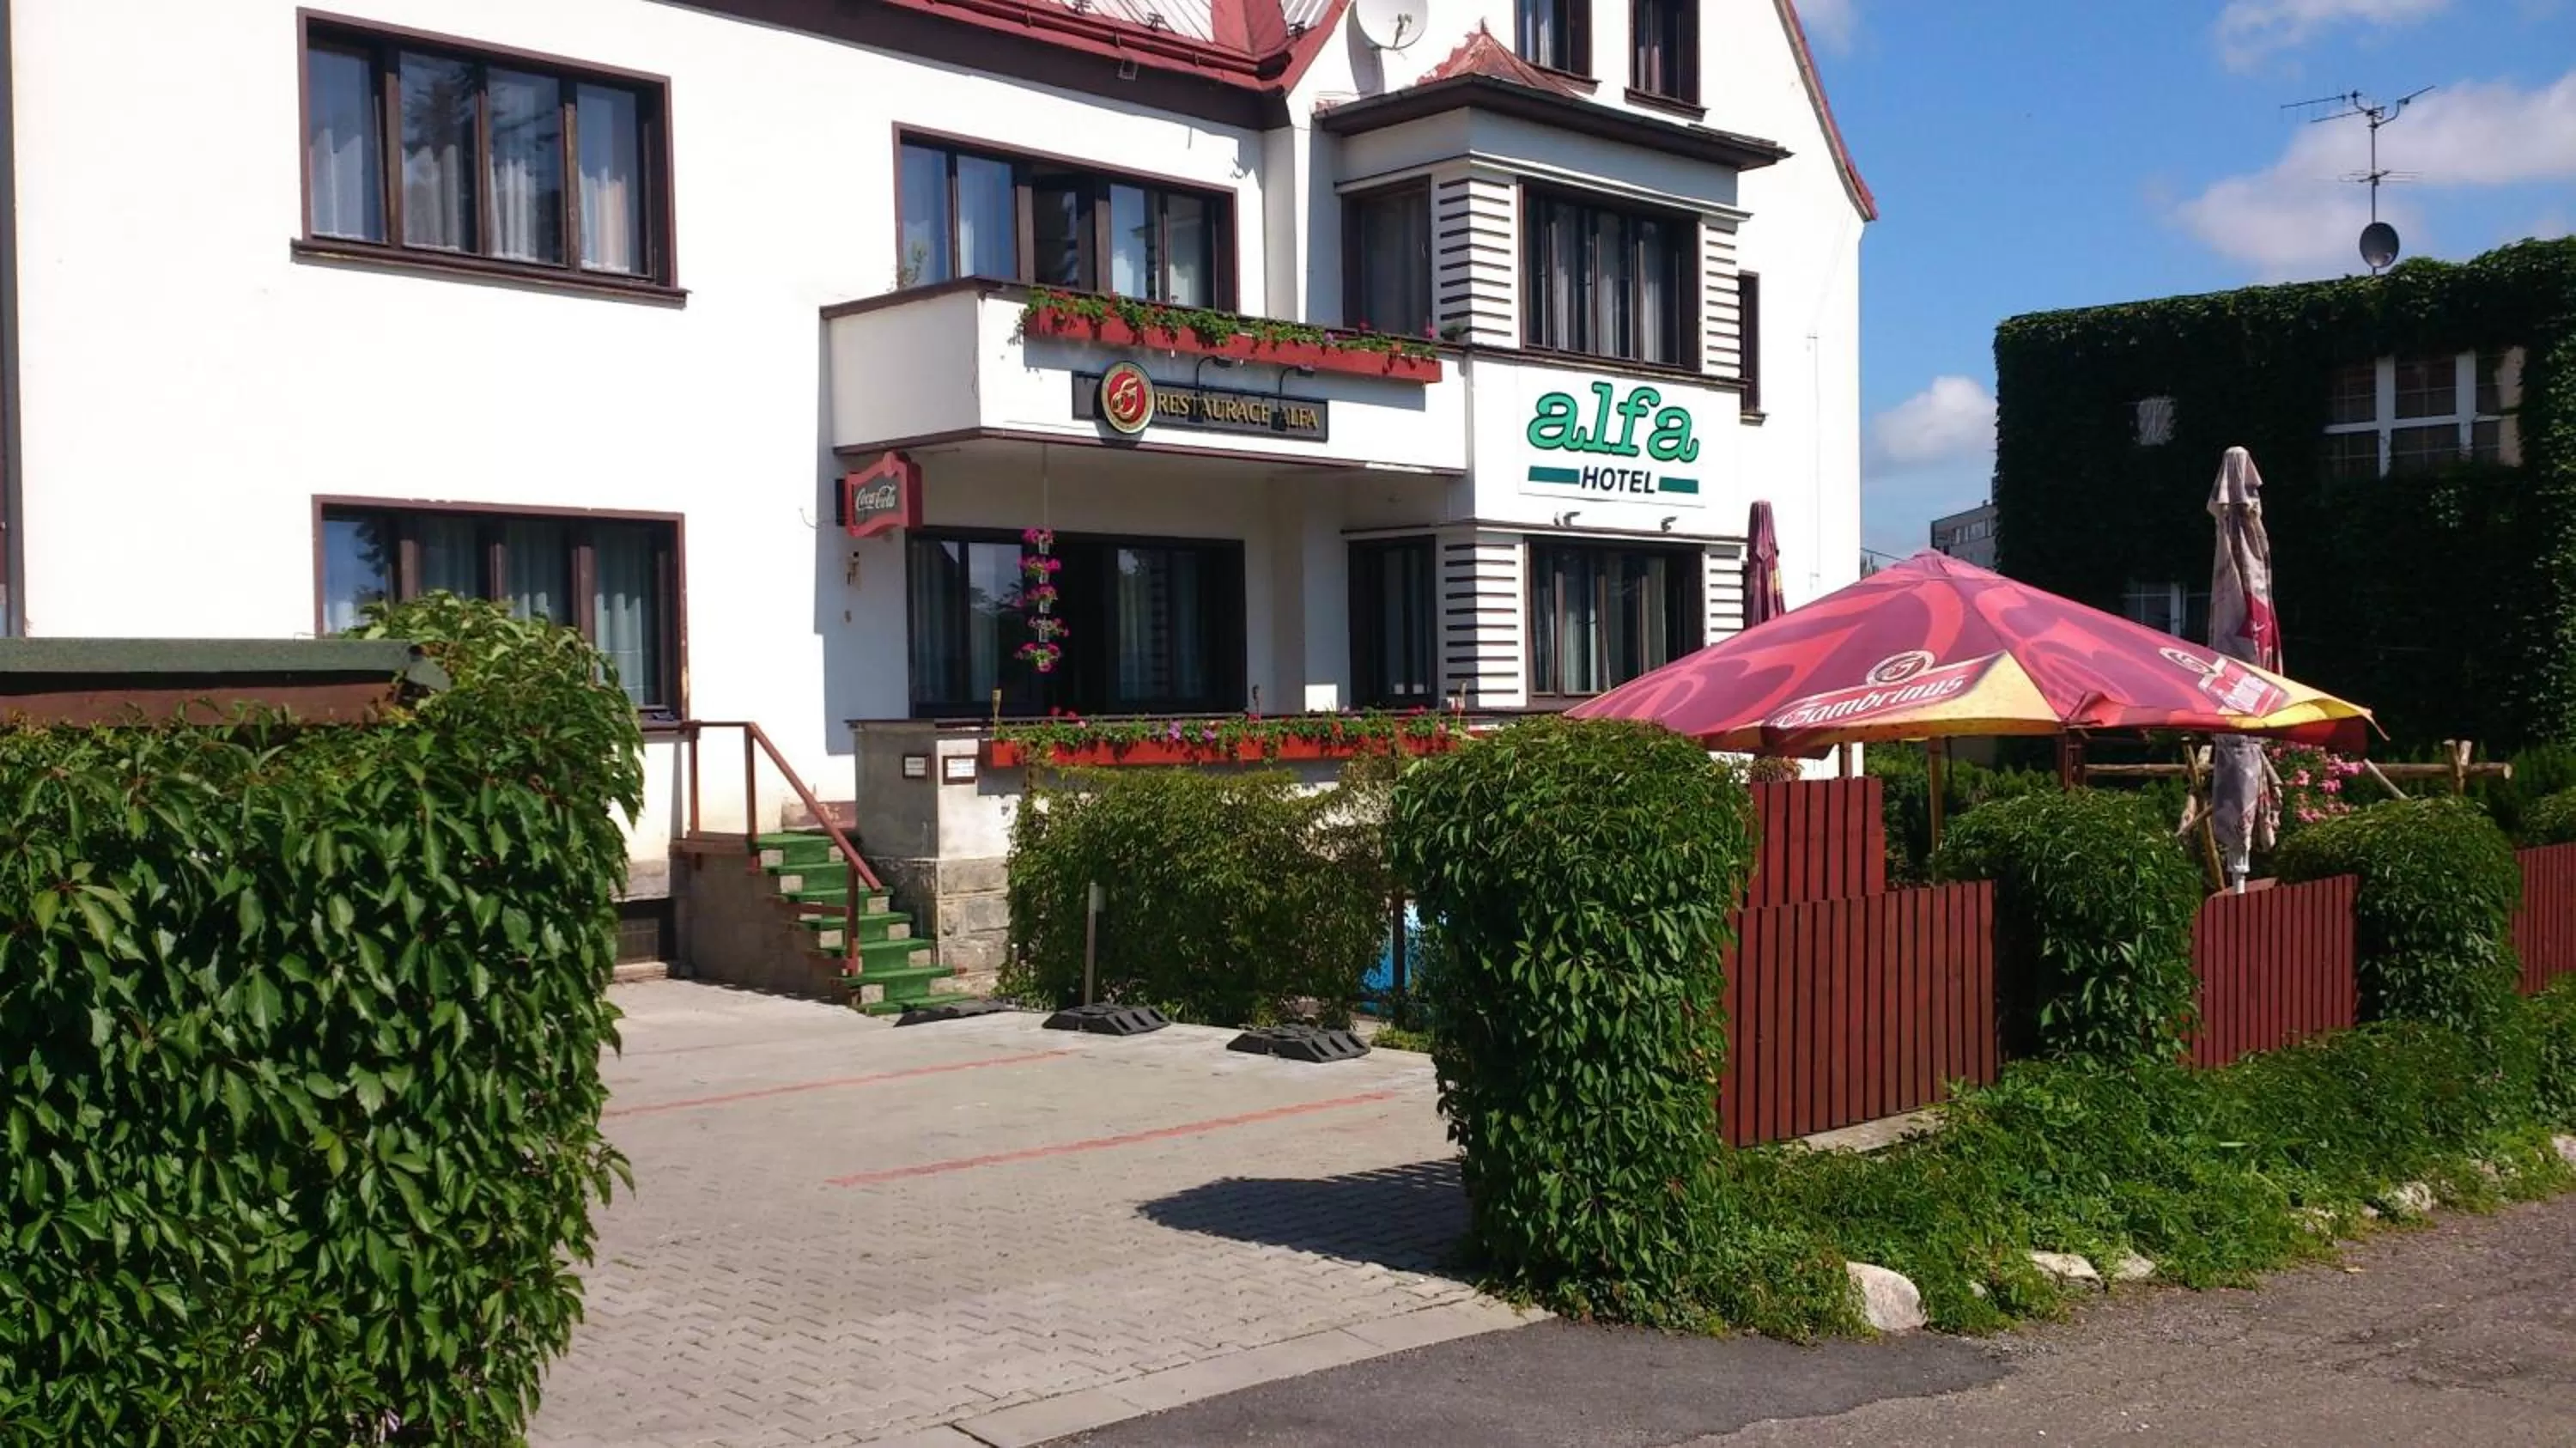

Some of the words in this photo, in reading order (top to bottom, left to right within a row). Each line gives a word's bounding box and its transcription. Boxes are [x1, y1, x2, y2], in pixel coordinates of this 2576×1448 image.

[1157, 392, 1271, 423] RESTAURACE
[1277, 405, 1318, 429] ALFA
[1527, 381, 1699, 462] alfa
[1581, 465, 1656, 494] HOTEL
[1774, 675, 1965, 729] Gambrinus
